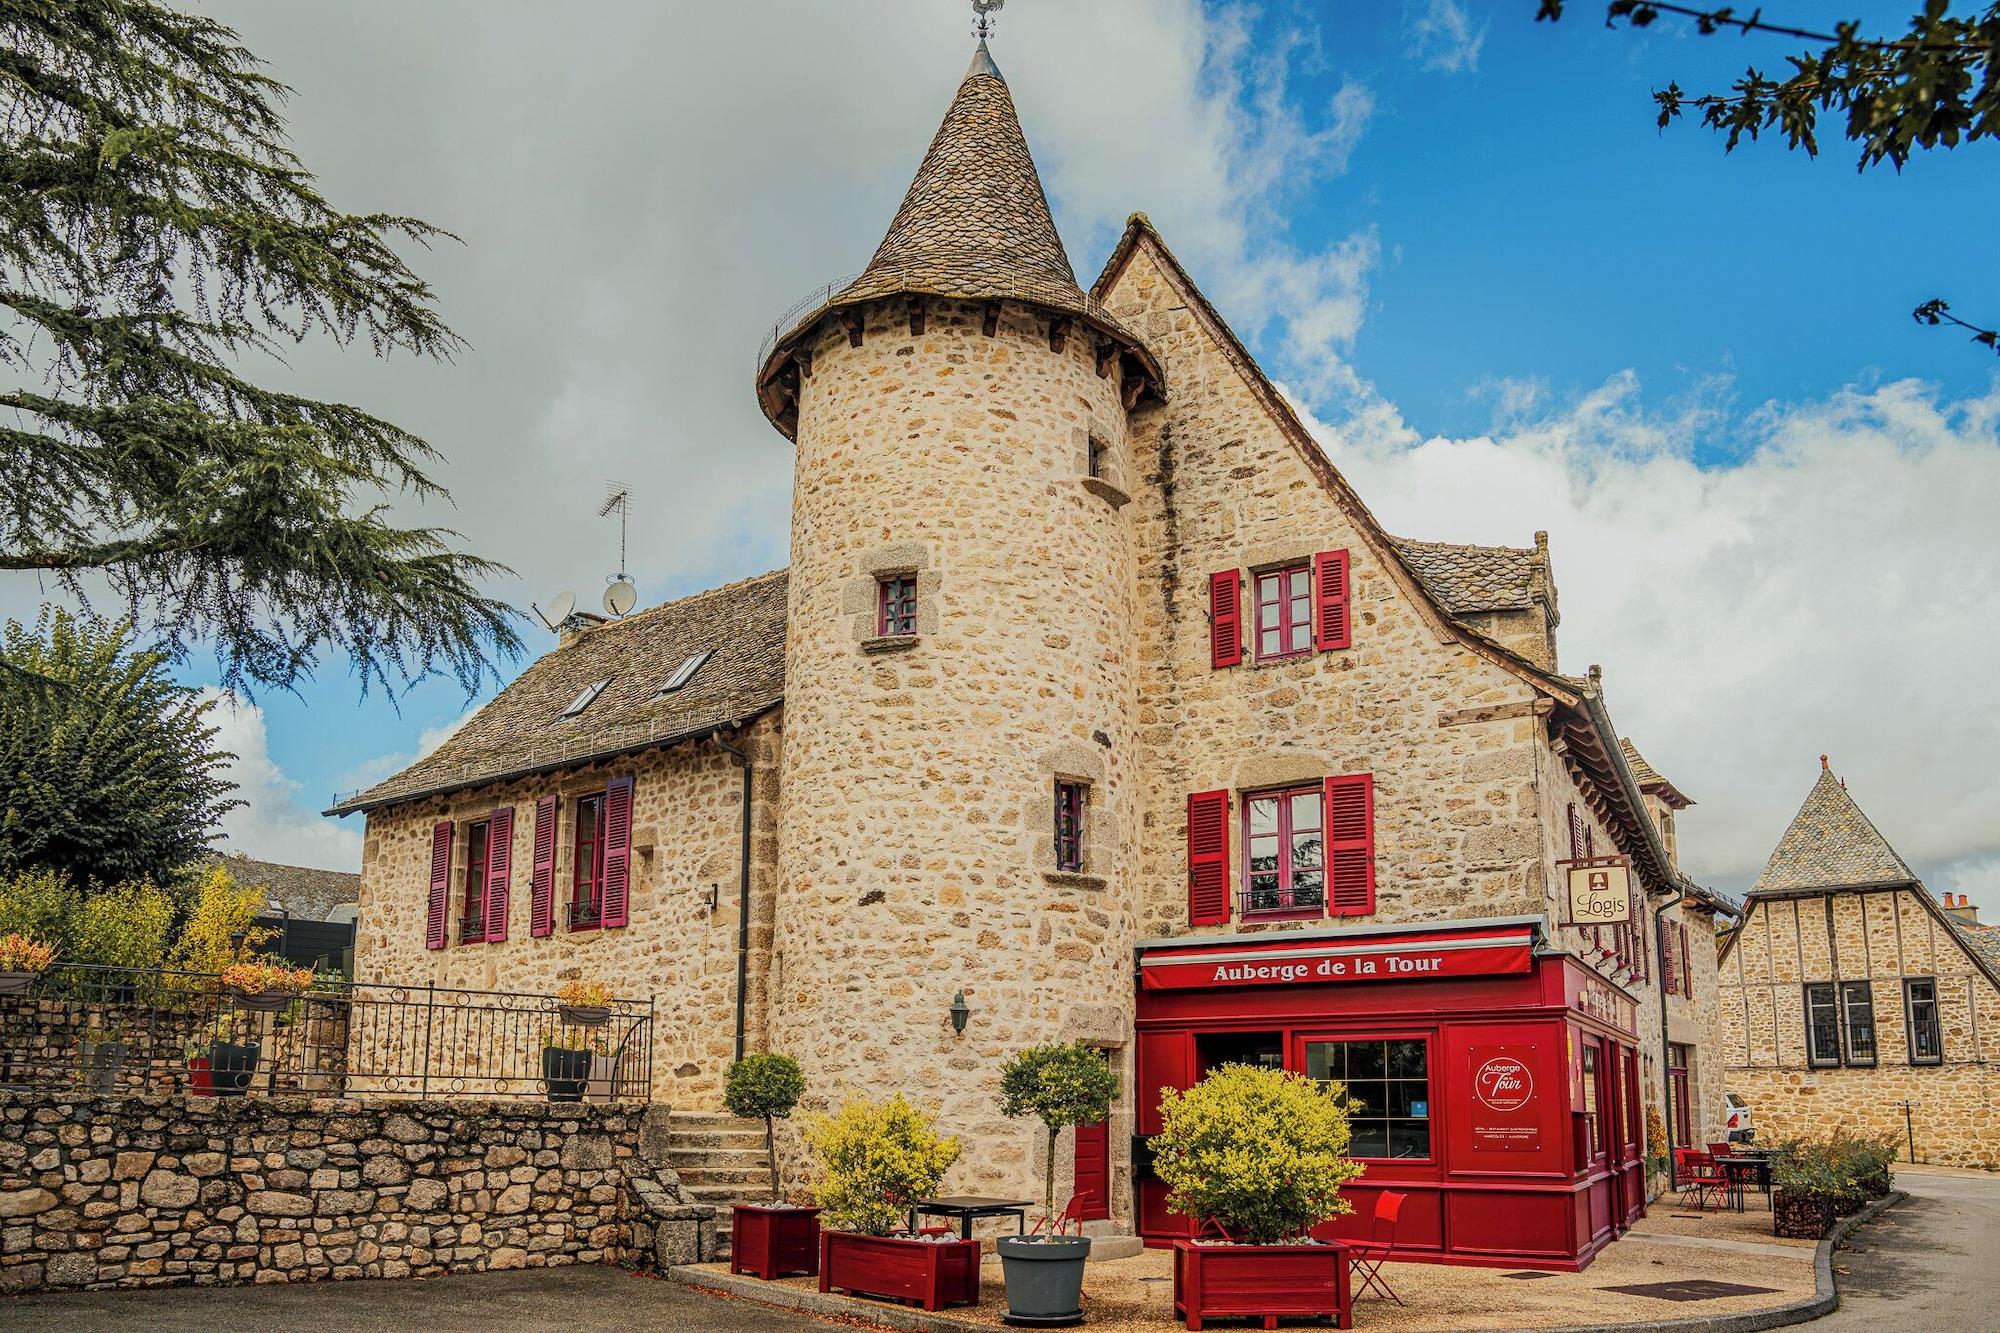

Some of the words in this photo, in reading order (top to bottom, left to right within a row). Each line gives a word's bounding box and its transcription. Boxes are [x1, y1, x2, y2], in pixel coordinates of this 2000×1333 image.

[1576, 892, 1625, 918] Logis
[1213, 964, 1309, 982] Auberge
[1316, 959, 1346, 976] de
[1354, 958, 1376, 974] la
[1385, 956, 1442, 973] Tour
[1485, 1065, 1520, 1073] Auberge
[1482, 1071, 1522, 1097] Tour
